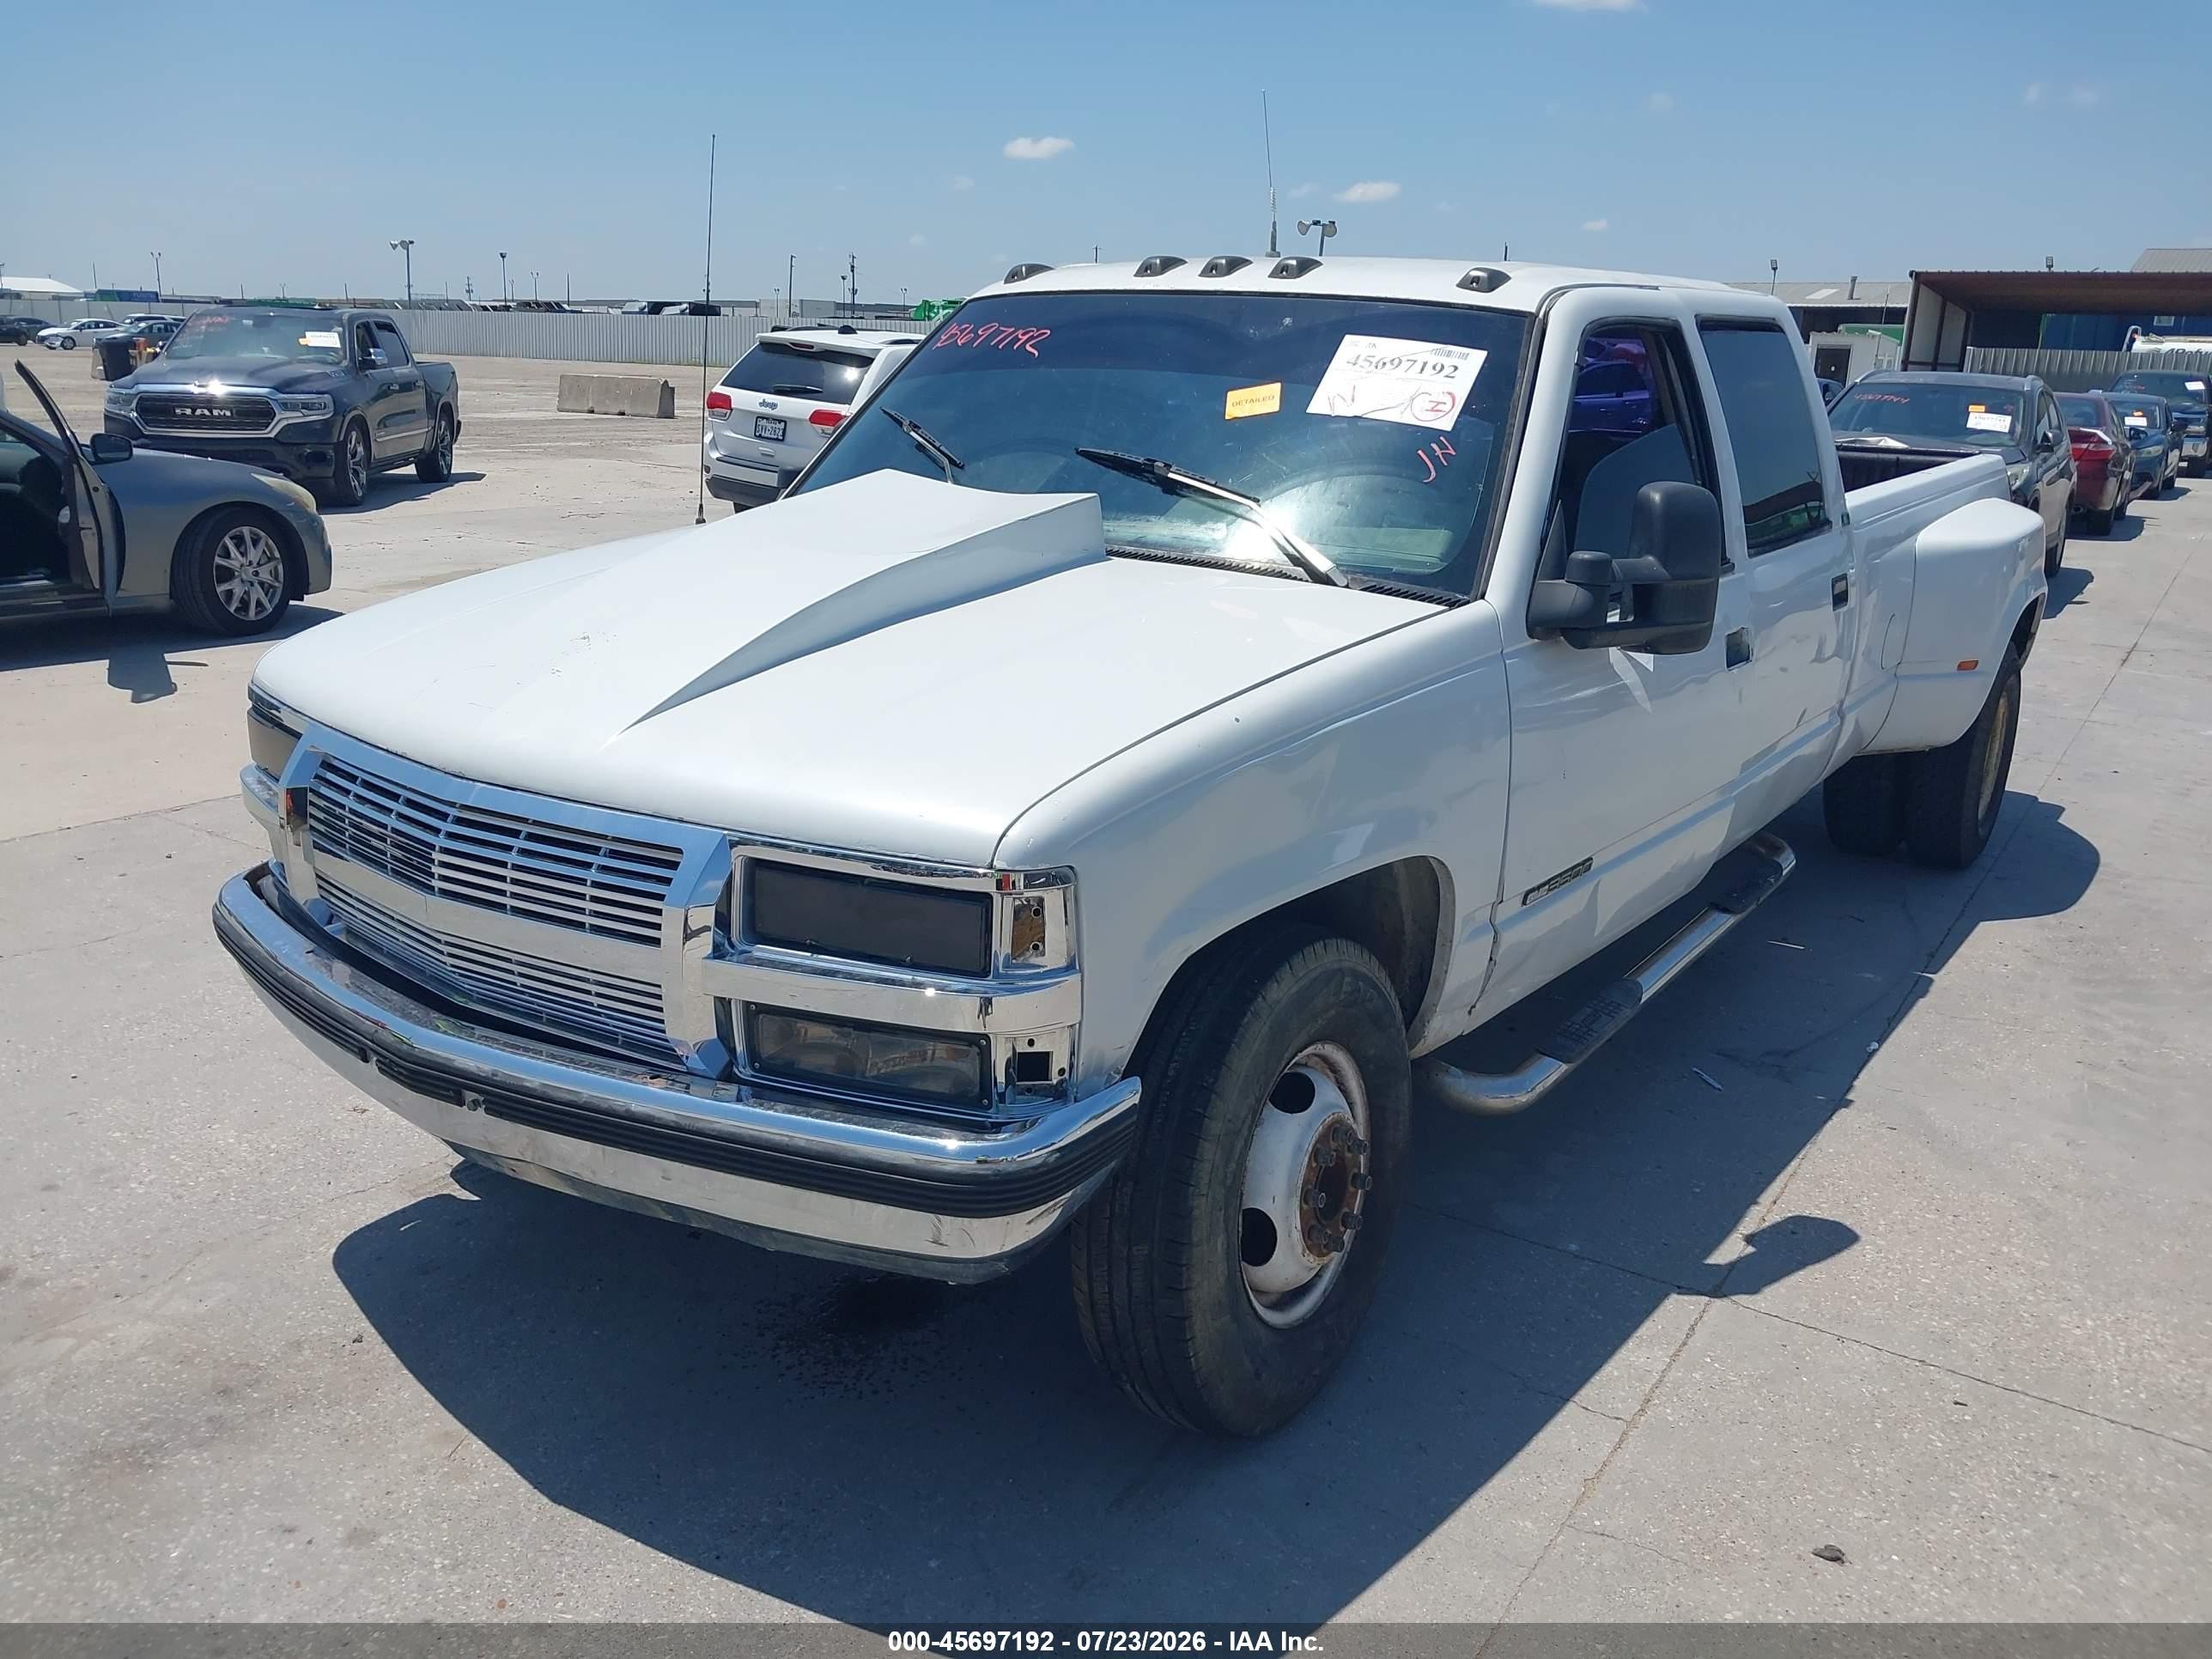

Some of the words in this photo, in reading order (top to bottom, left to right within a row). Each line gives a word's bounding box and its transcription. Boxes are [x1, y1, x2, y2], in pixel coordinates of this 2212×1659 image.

[1346, 353, 1459, 380] 45697192
[758, 398, 779, 411] Jeep
[1231, 394, 1275, 408] DETAILED
[173, 407, 232, 417] RAM
